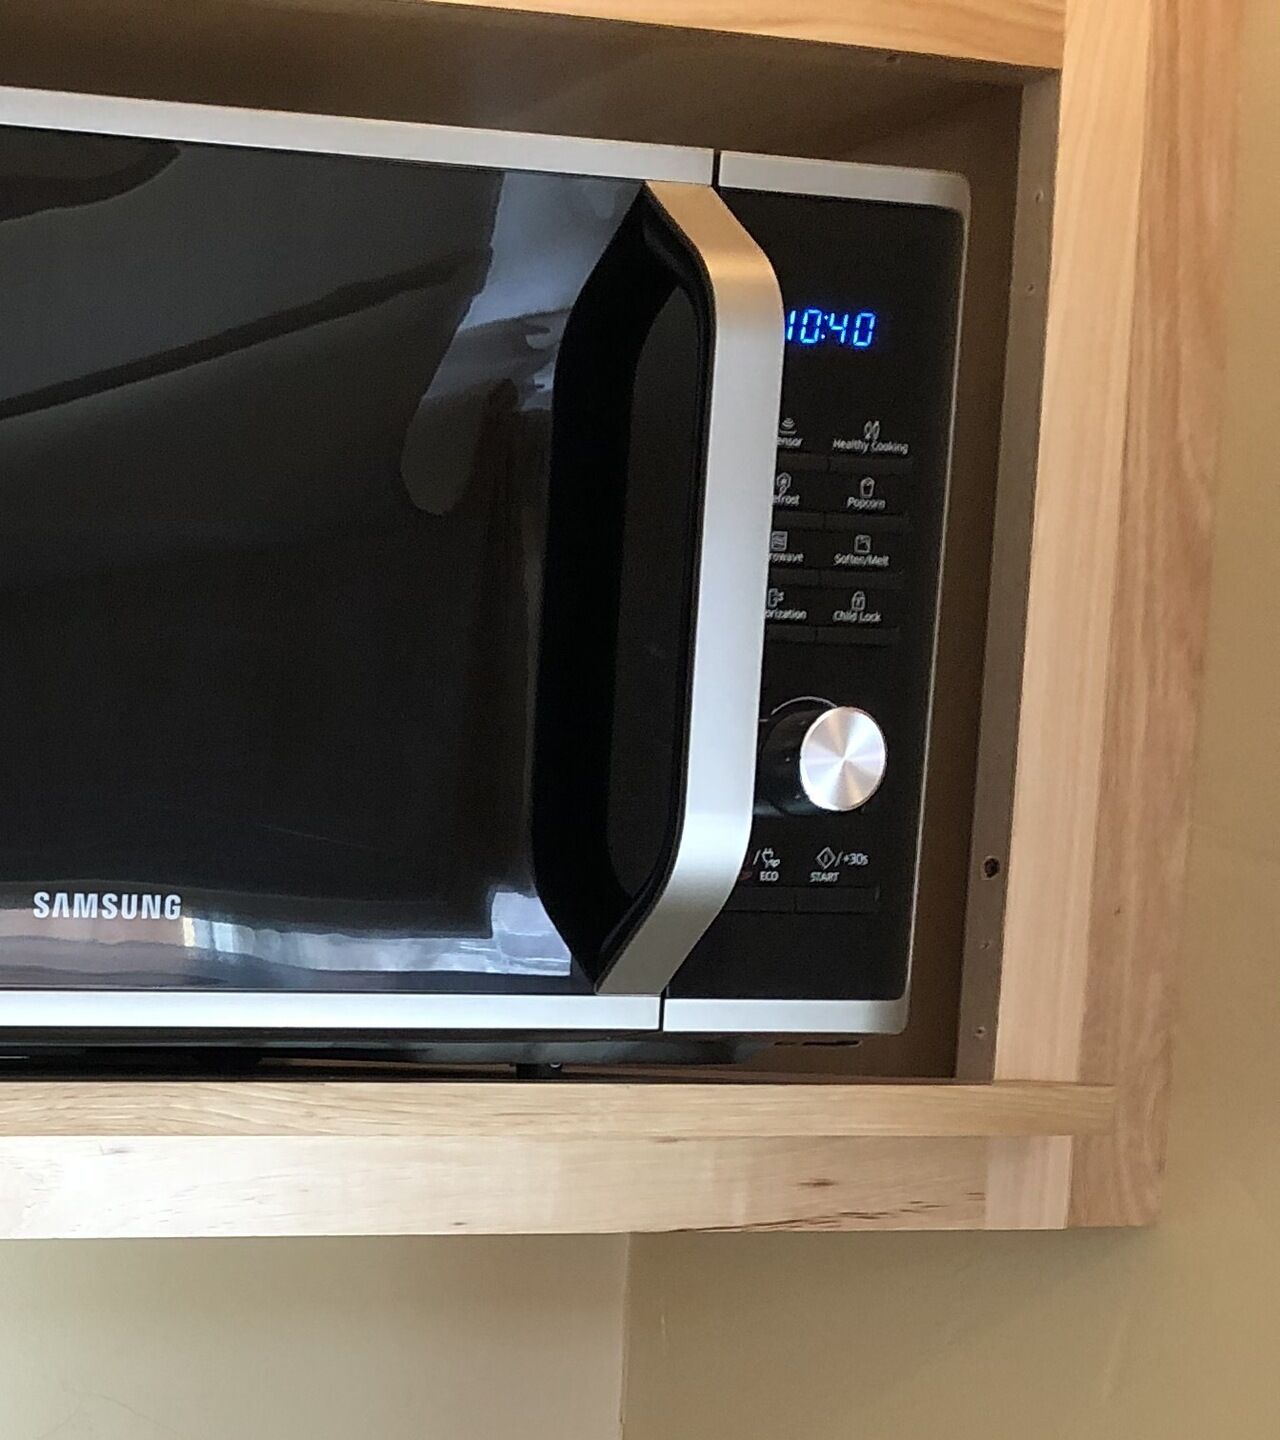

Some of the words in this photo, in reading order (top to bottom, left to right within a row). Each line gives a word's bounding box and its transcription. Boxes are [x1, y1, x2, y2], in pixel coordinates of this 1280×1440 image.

[787, 309, 876, 347] 10:40
[777, 436, 803, 447] ensor
[833, 438, 869, 454] Healthy
[871, 441, 909, 455] Cooking
[847, 497, 886, 510] Popcorn
[833, 553, 890, 567] Soften/Melt
[832, 610, 858, 622] Child
[859, 612, 882, 623] Lock
[760, 871, 780, 882] ECO
[809, 871, 840, 883] START
[33, 892, 182, 920] SAMSUNG
